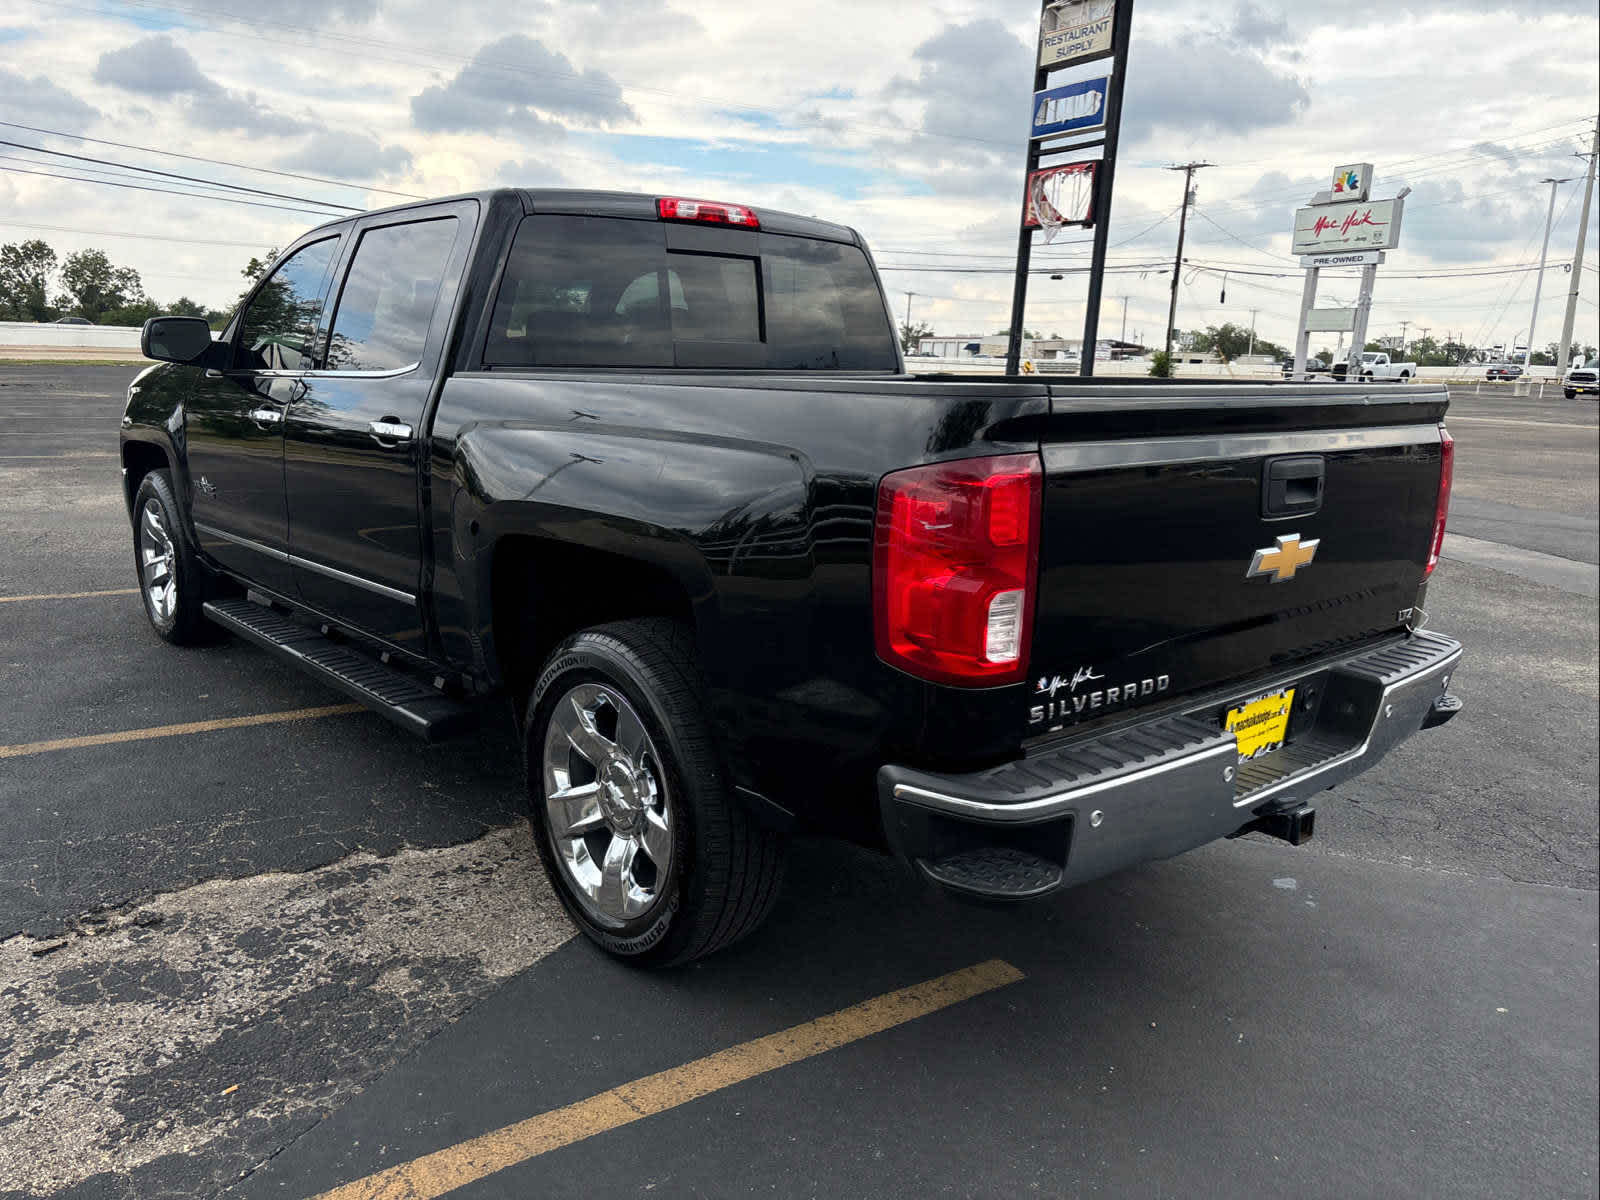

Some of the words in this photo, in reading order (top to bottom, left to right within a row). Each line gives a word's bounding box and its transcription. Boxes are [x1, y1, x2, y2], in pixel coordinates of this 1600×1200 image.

[1044, 20, 1109, 48] RESTAURANT
[1056, 39, 1094, 57] SUPPLY
[1309, 216, 1340, 238] Mac
[1340, 208, 1378, 236] Haik
[1313, 255, 1364, 265] PRE-OWNED
[536, 656, 578, 697] DESTINATION
[1028, 674, 1169, 724] SILVERADO
